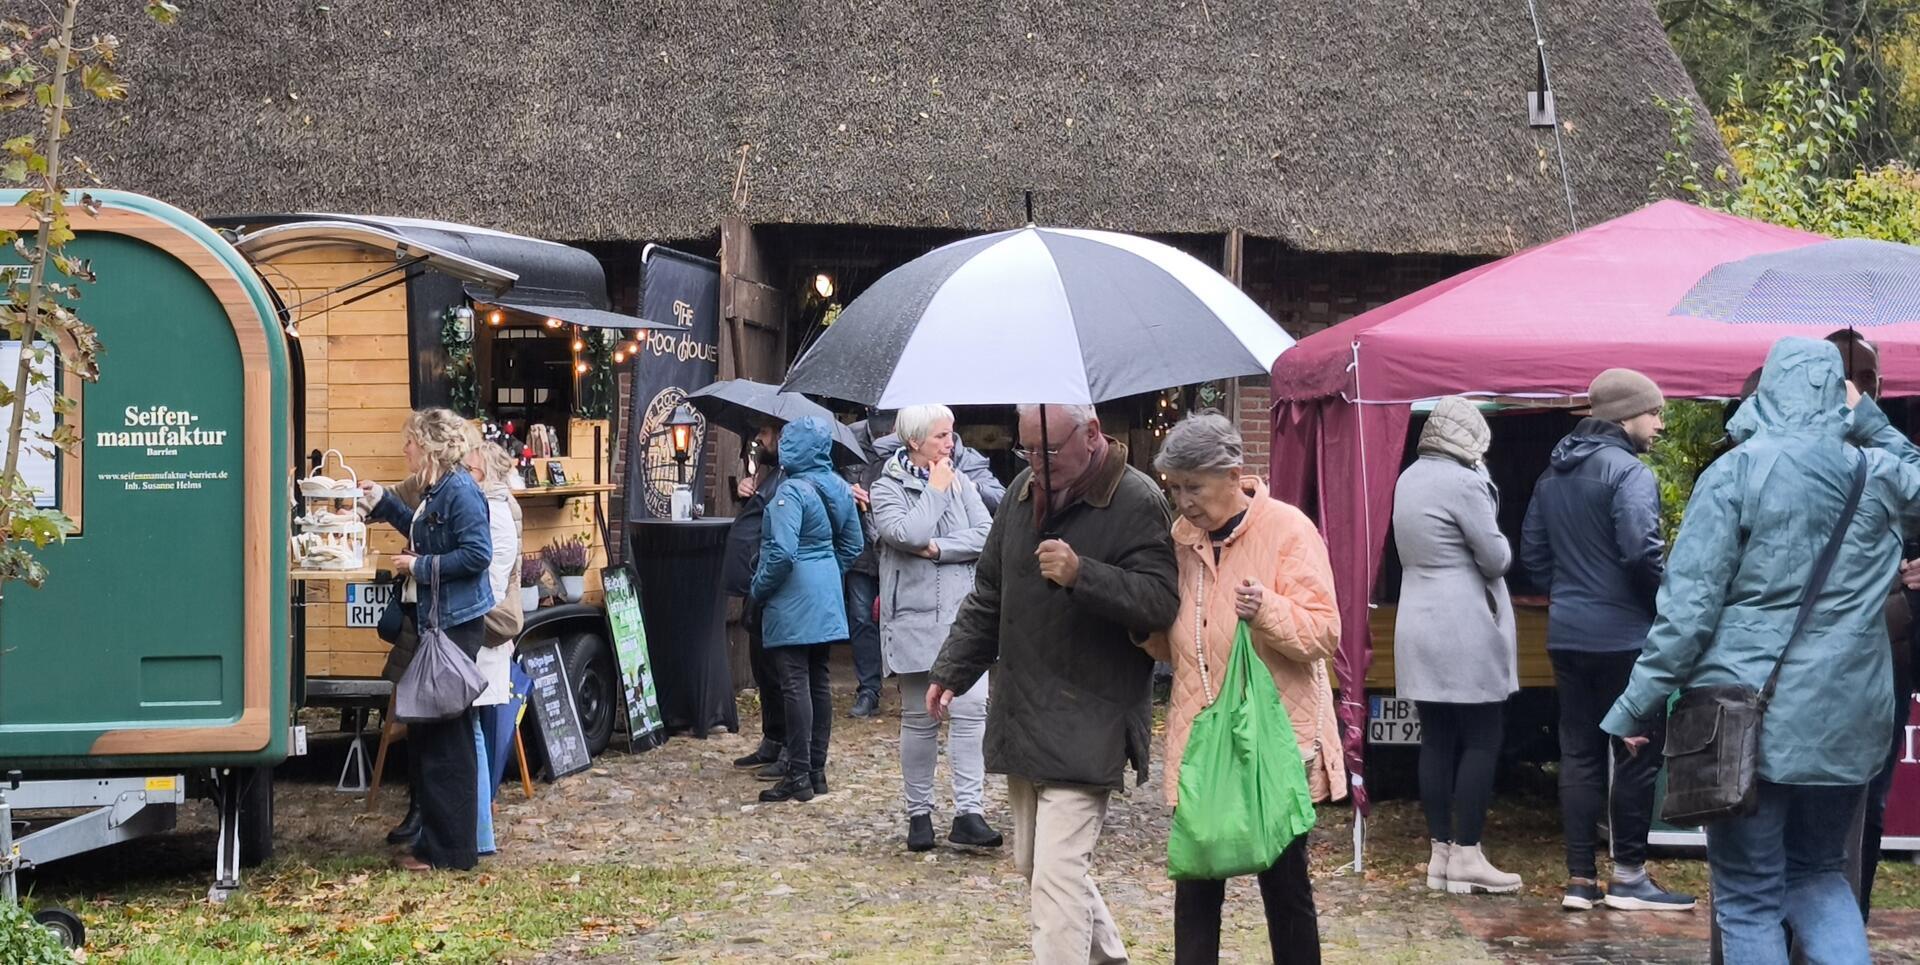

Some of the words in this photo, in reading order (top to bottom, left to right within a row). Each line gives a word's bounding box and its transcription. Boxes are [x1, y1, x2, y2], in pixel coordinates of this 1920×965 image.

[124, 405, 199, 427] Seifen-
[96, 426, 228, 447] manufaktur
[146, 448, 178, 456] Barrien
[97, 470, 229, 481] www.seifenmanufaktur-barrien.de
[124, 481, 141, 491] Inh.
[141, 481, 175, 491] Susanne
[176, 481, 202, 490] Helms
[1383, 700, 1409, 719] HB
[1371, 721, 1397, 741] QT
